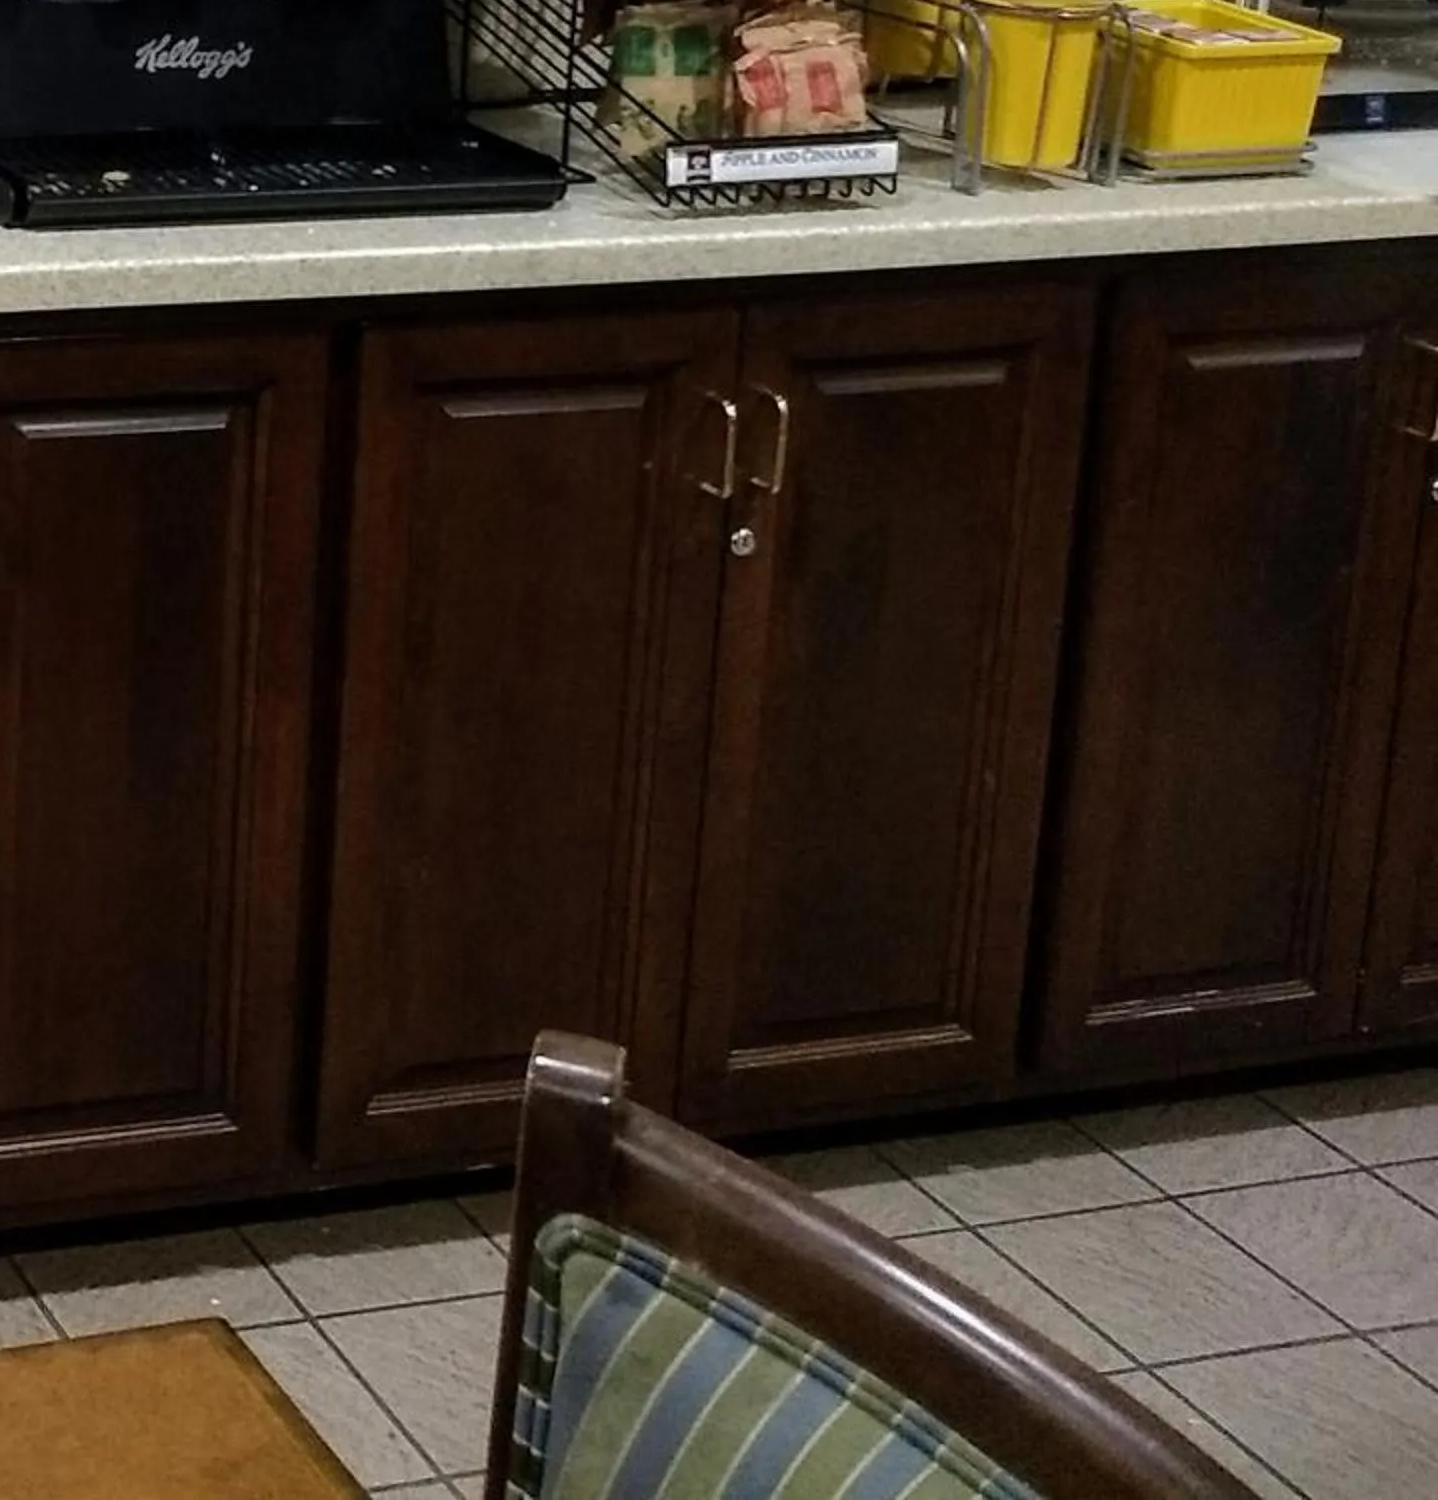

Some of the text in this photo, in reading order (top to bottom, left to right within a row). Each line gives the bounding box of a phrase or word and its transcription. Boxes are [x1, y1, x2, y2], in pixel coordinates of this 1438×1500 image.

[134, 33, 254, 79] Kellogg's
[720, 146, 879, 168] APPLE AND CINNAMON
